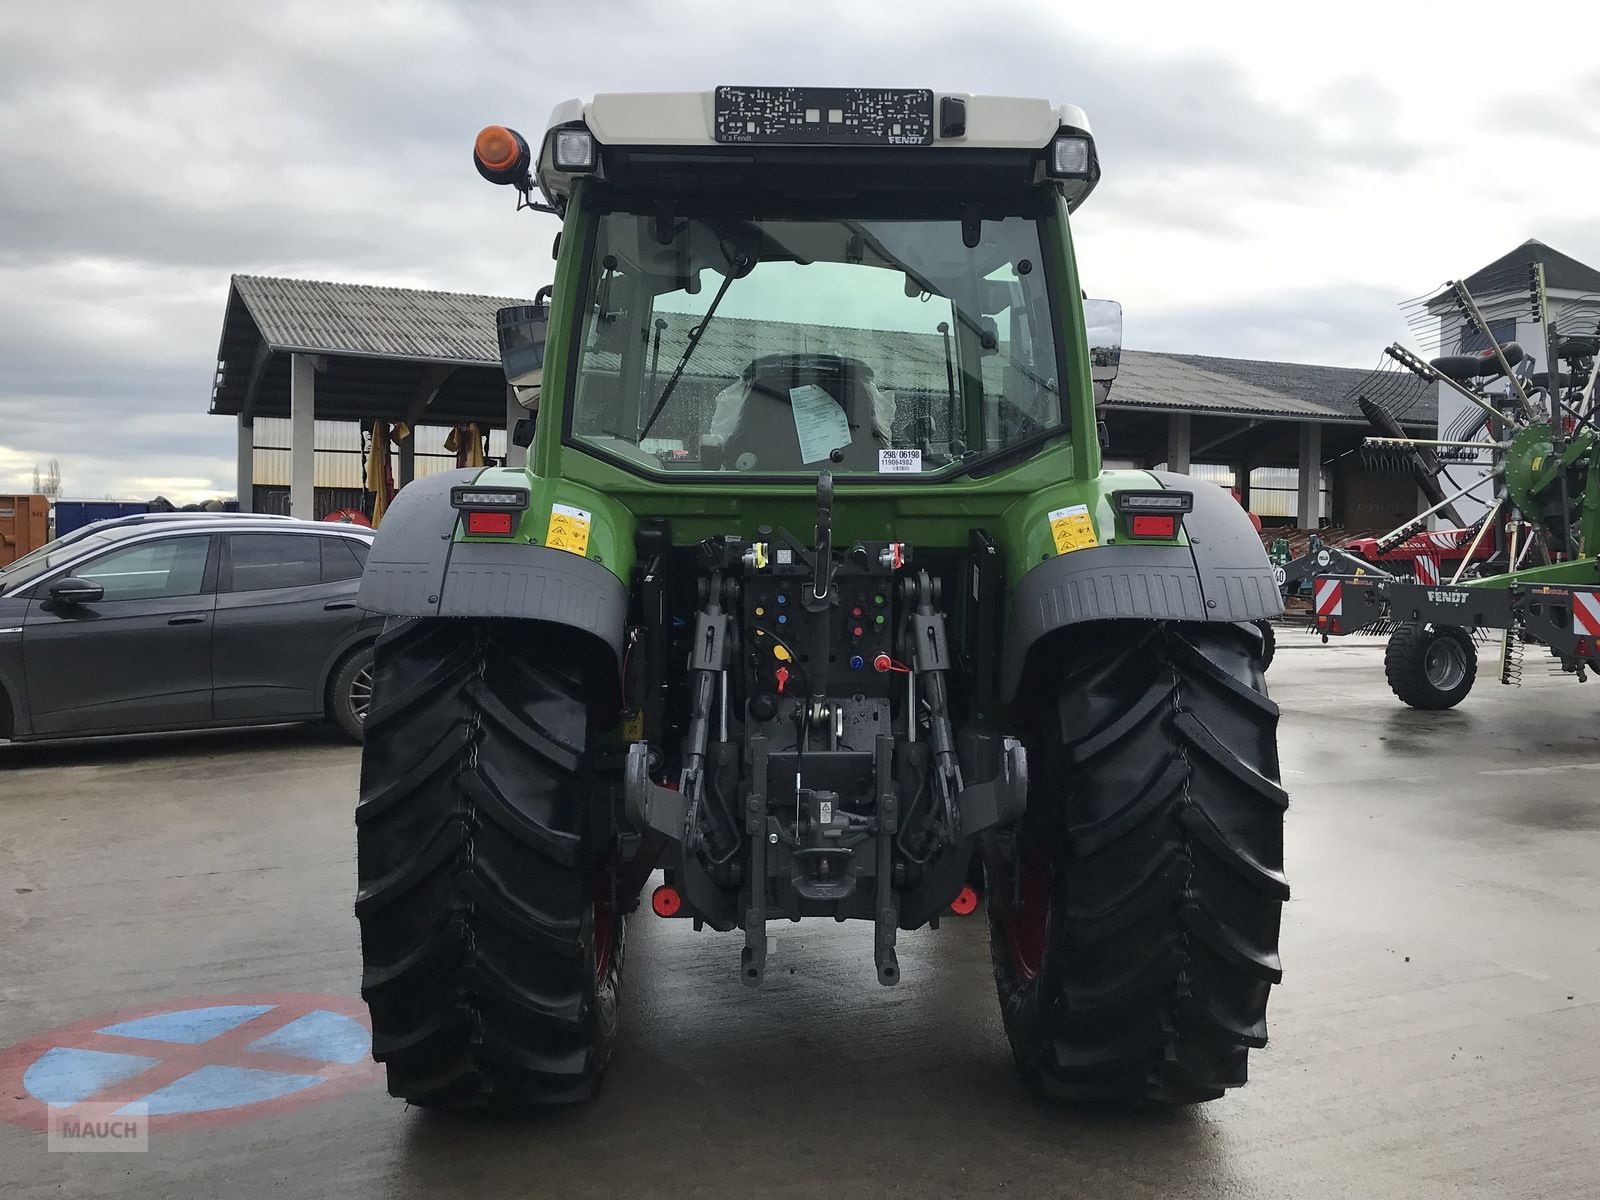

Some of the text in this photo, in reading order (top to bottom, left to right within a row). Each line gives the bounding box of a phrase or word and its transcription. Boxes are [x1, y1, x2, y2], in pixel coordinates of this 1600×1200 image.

[733, 134, 752, 142] Fendt
[887, 136, 925, 144] FENDT
[1427, 590, 1470, 603] FENDT
